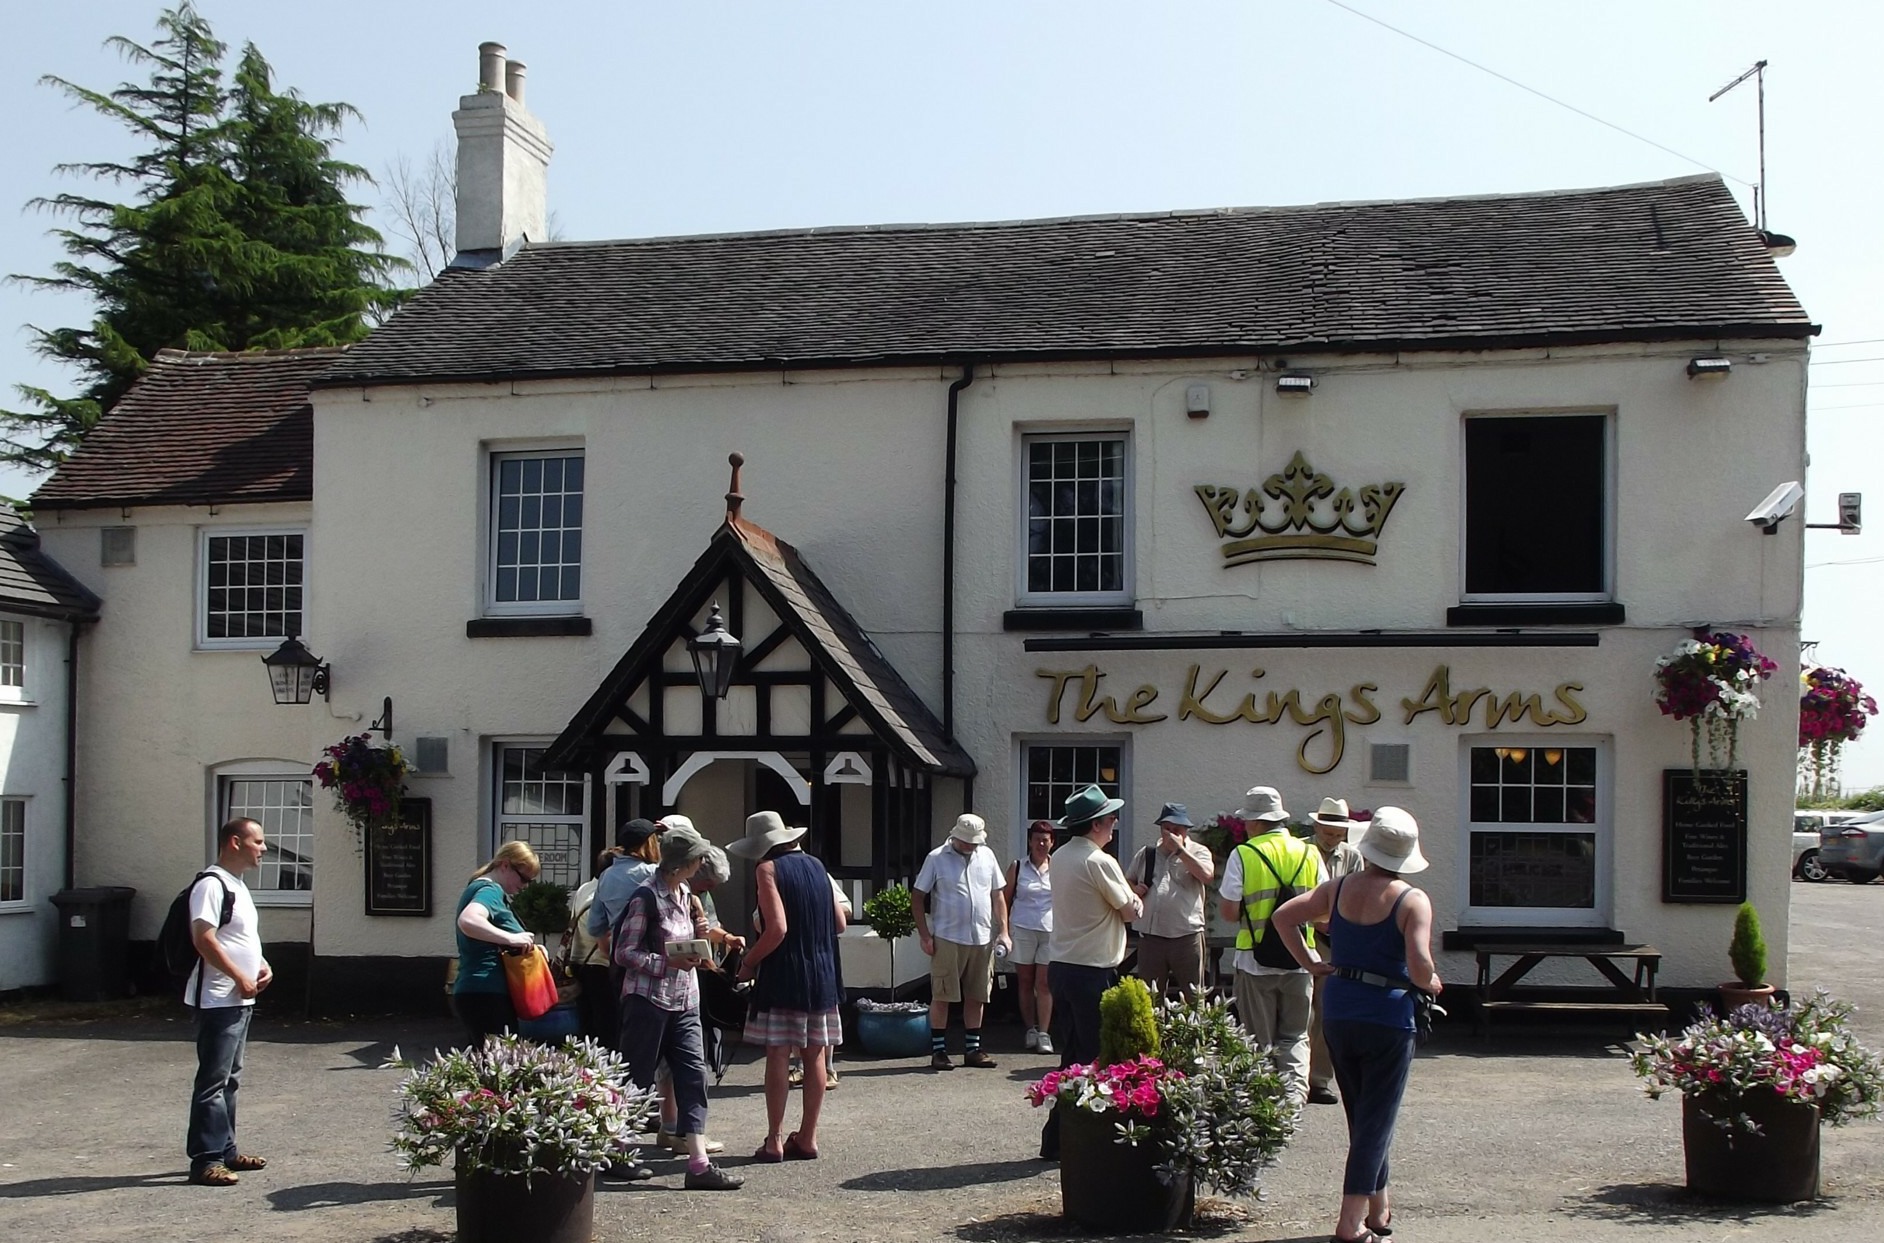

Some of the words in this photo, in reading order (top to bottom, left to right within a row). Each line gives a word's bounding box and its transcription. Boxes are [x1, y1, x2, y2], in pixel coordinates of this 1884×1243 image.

[1036, 663, 1169, 725] The
[1178, 663, 1382, 775] Kings
[1402, 663, 1588, 730] Arms
[544, 852, 567, 862] ROOM
